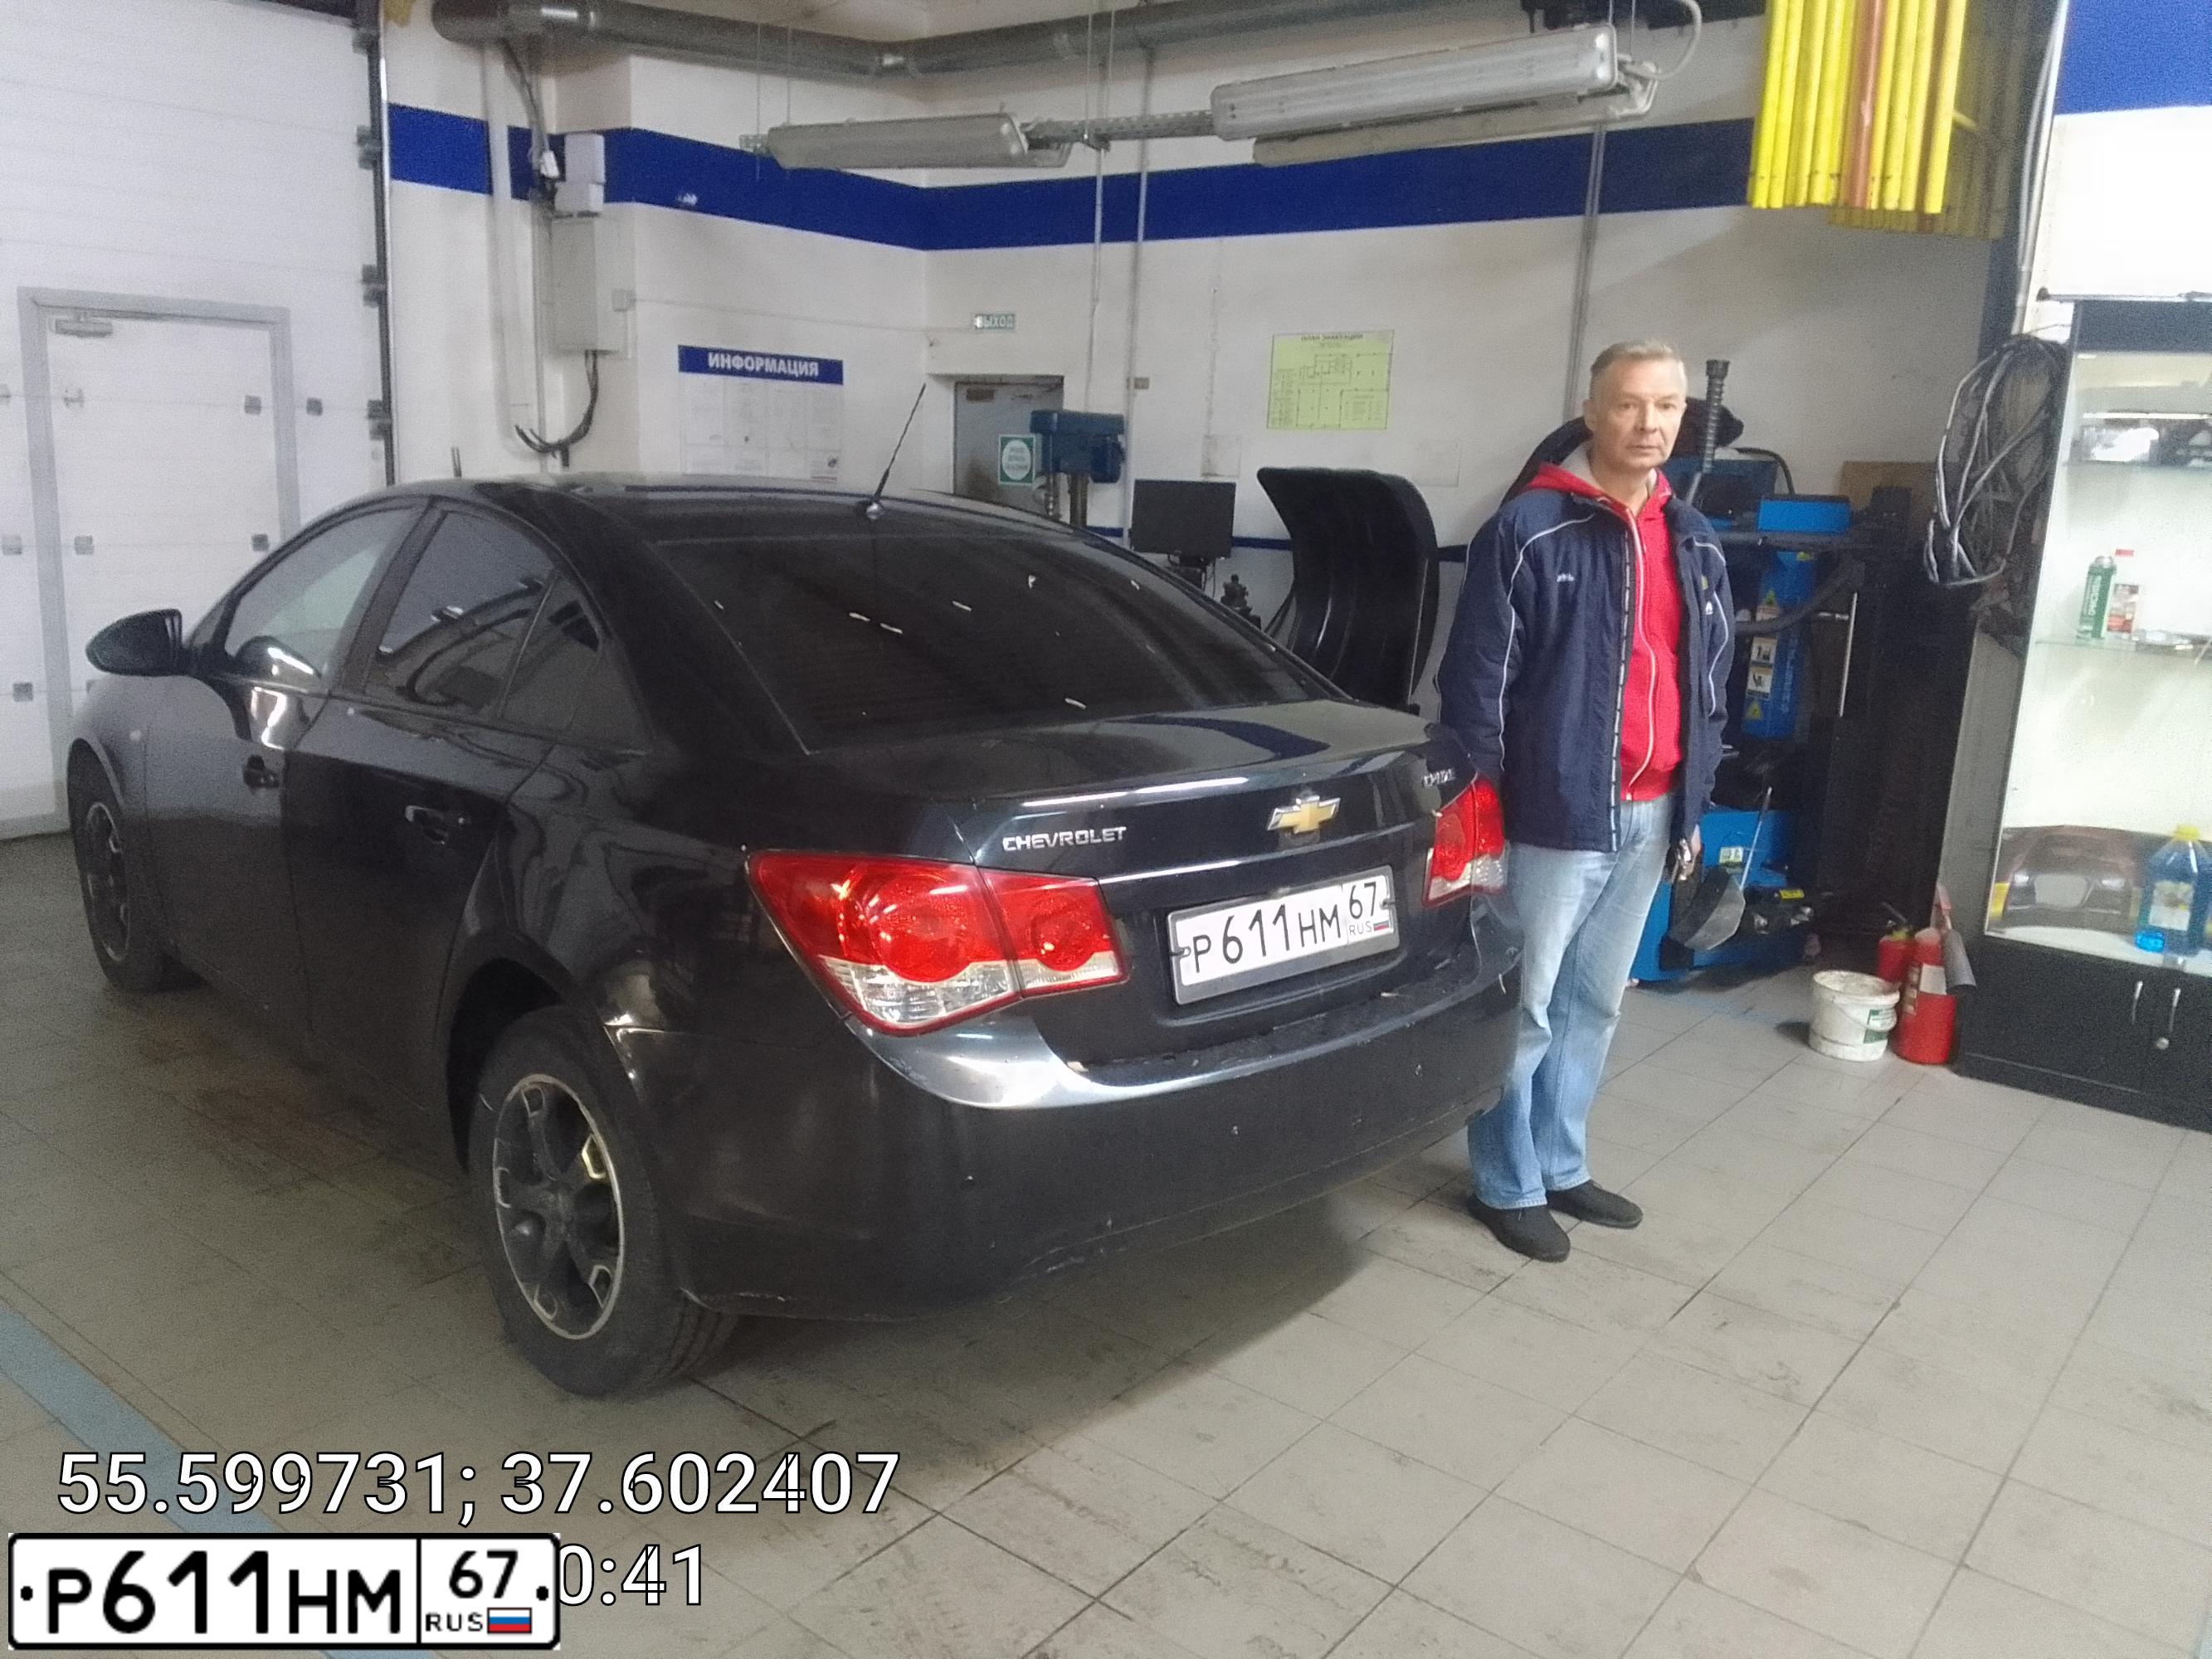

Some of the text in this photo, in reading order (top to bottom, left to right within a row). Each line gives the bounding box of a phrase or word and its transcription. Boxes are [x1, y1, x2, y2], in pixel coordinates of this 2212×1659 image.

[708, 352, 819, 377] ИНФОРМАЦИЯ
[1002, 826, 1127, 852] CHEVROLET
[1348, 881, 1377, 920] 67
[1348, 921, 1373, 936] RUS
